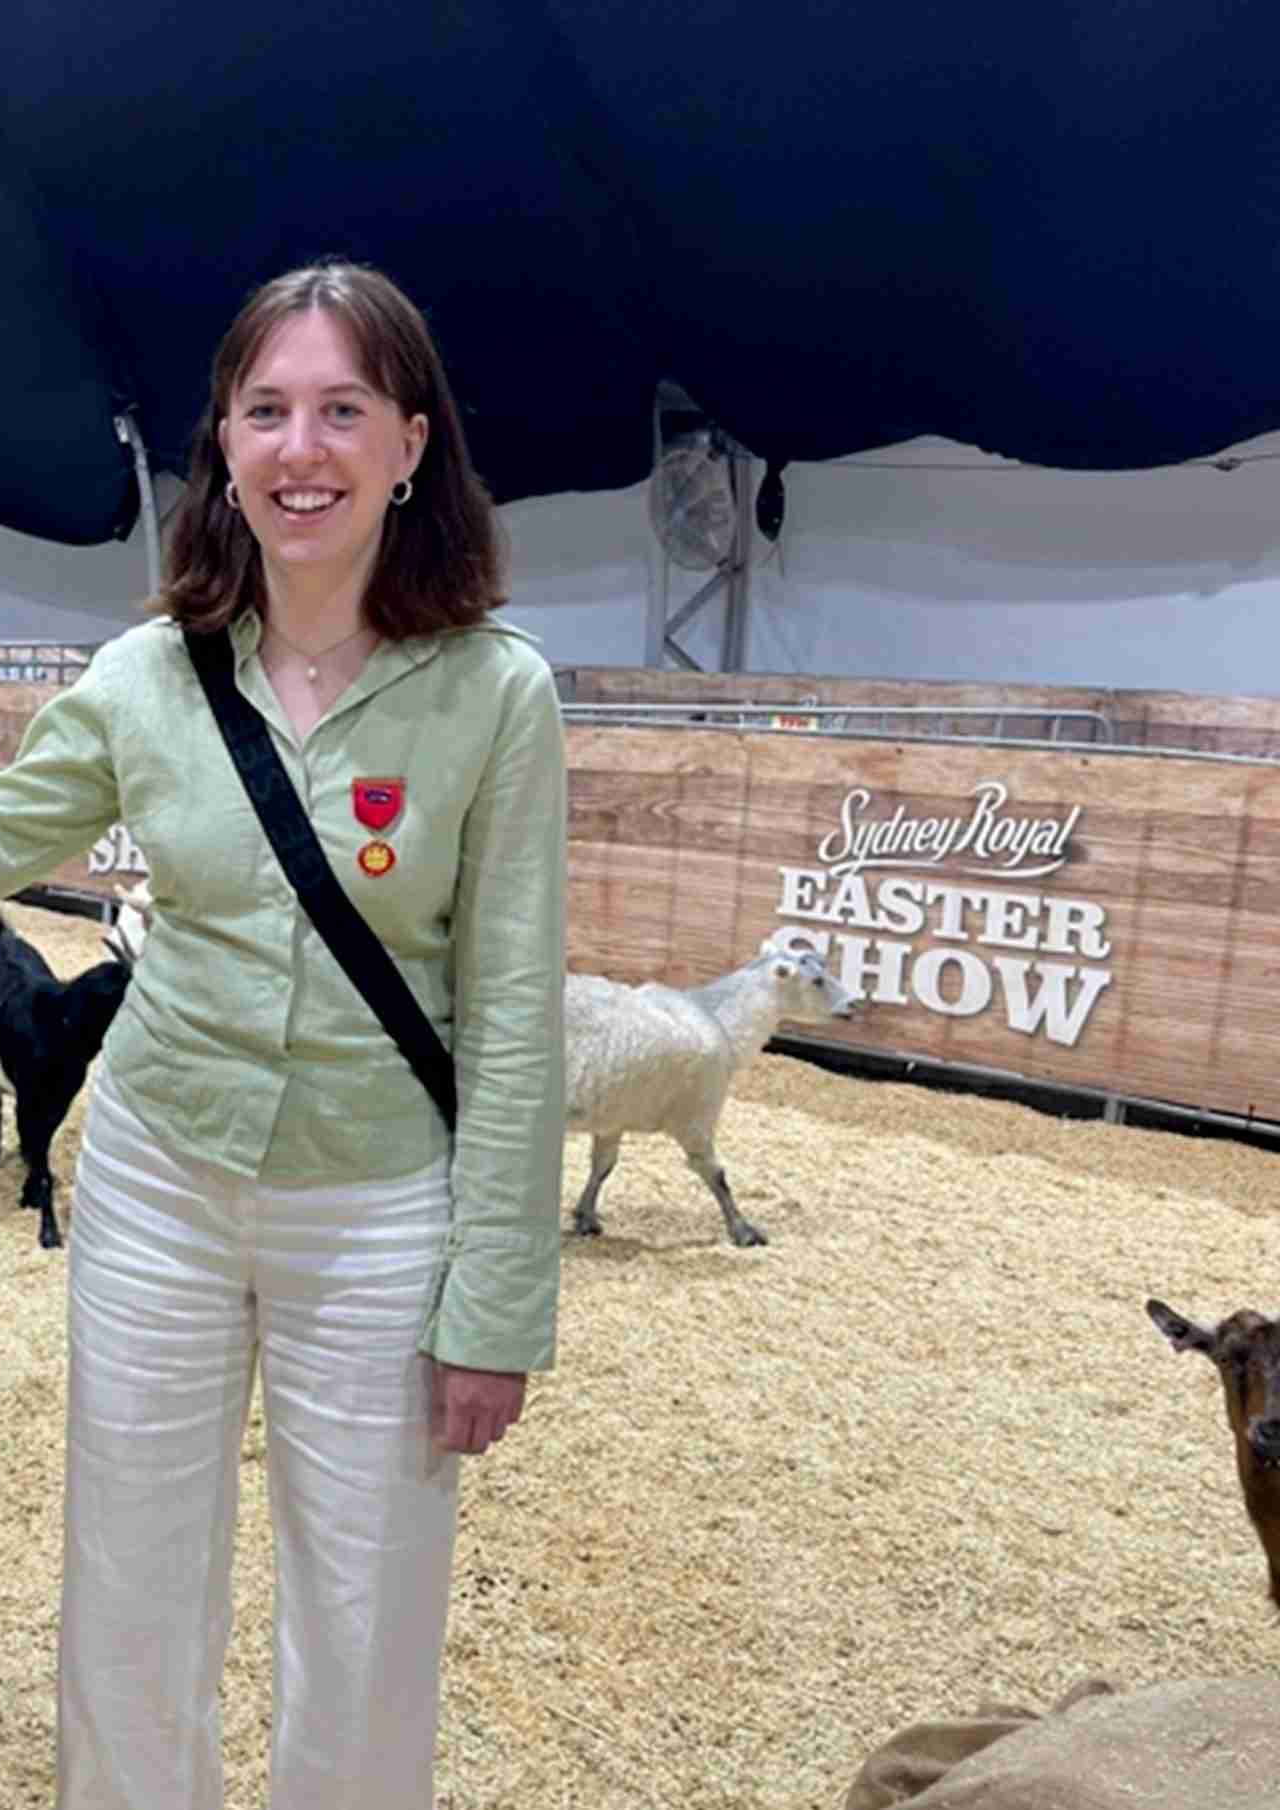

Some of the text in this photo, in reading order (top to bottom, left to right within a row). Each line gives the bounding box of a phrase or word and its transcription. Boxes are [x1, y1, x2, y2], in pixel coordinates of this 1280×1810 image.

[817, 781, 1081, 873] Sydney Royal
[776, 866, 1111, 959] EASTER
